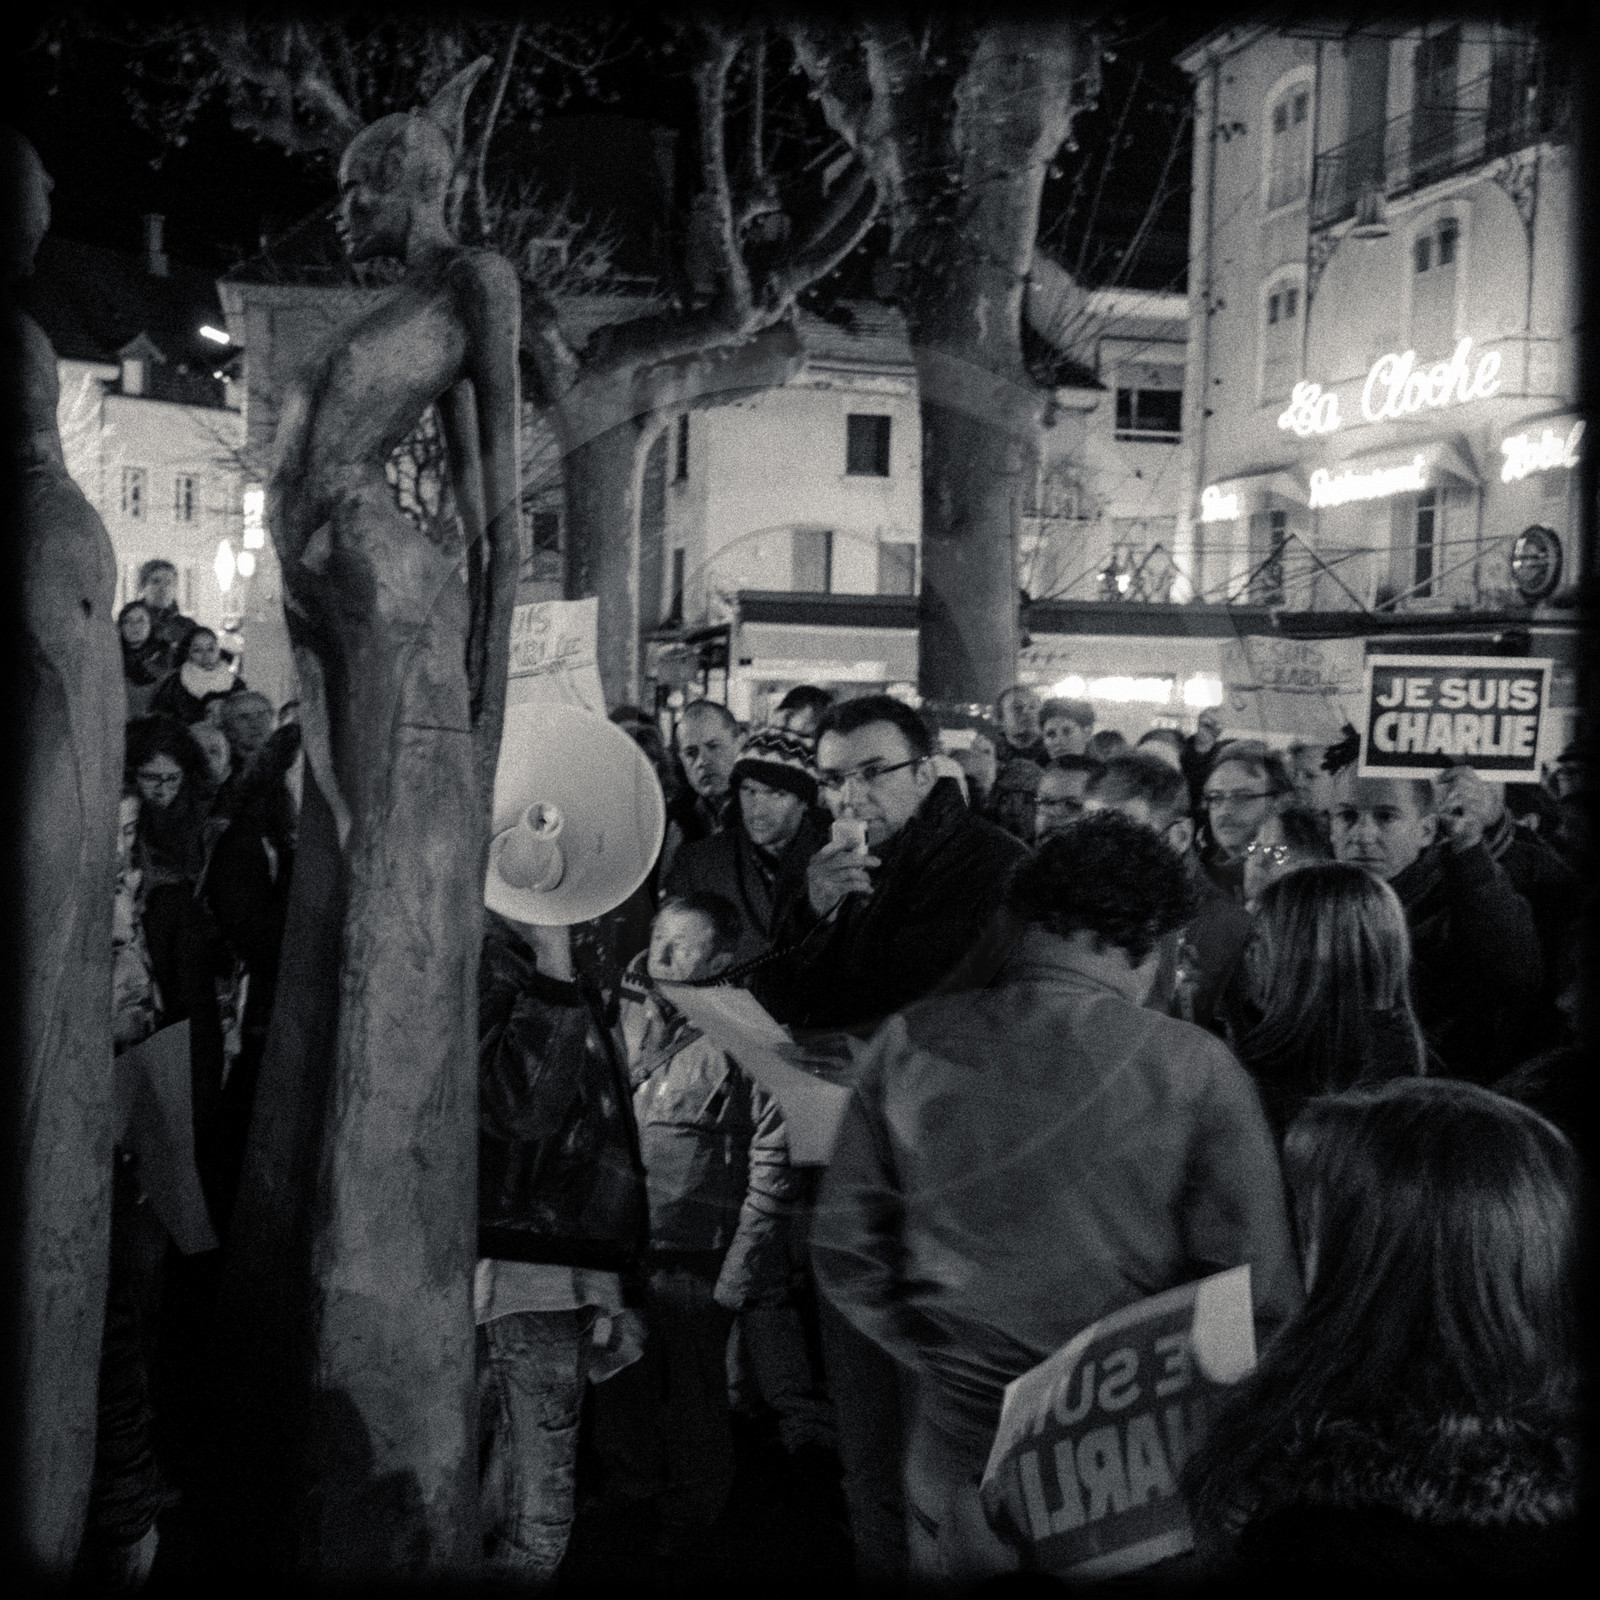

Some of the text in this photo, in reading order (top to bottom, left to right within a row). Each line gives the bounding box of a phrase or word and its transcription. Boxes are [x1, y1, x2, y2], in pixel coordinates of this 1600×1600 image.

[1360, 336, 1502, 422] Cloche
[1375, 677, 1434, 708] JE
[1438, 677, 1539, 711] SUIS
[1372, 710, 1538, 757] CHARLIE
